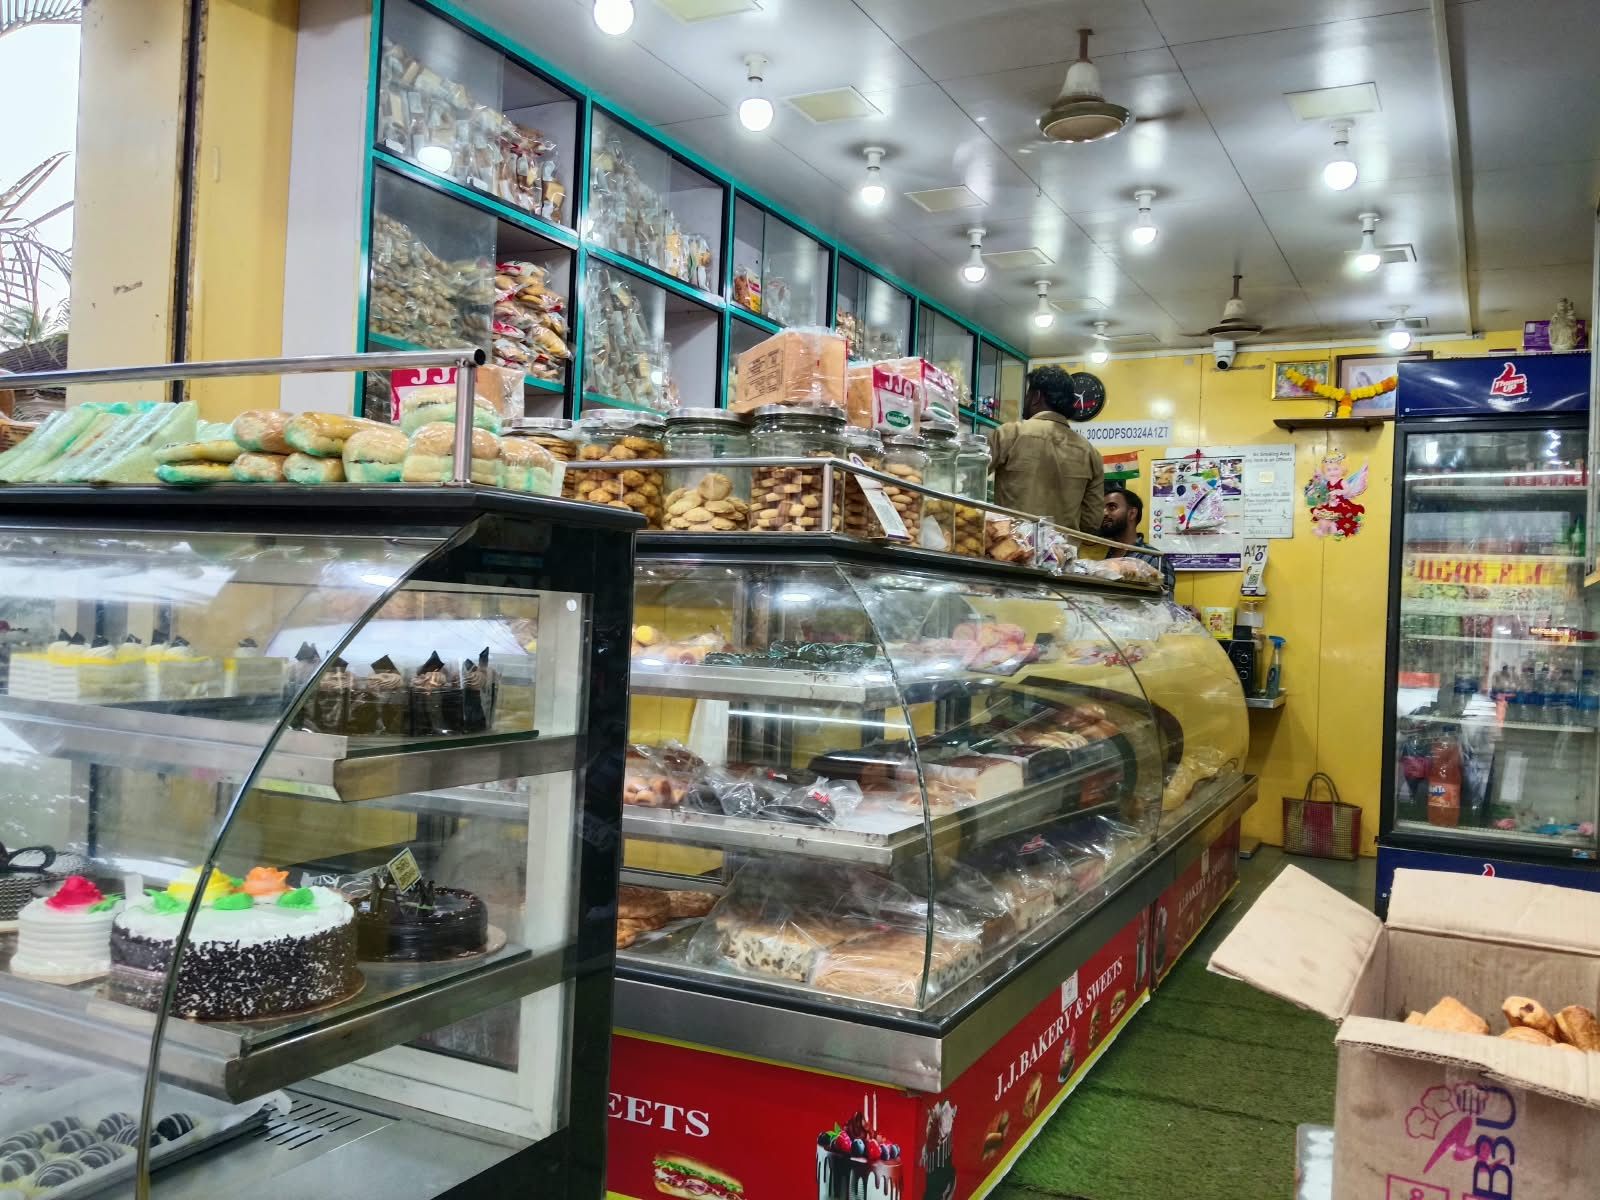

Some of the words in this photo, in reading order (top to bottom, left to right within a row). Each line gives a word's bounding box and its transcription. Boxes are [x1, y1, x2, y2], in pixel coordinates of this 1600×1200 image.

[1153, 510, 1162, 539] 2026
[1075, 998, 1084, 1019] &
[1086, 956, 1123, 1008] SWEETS
